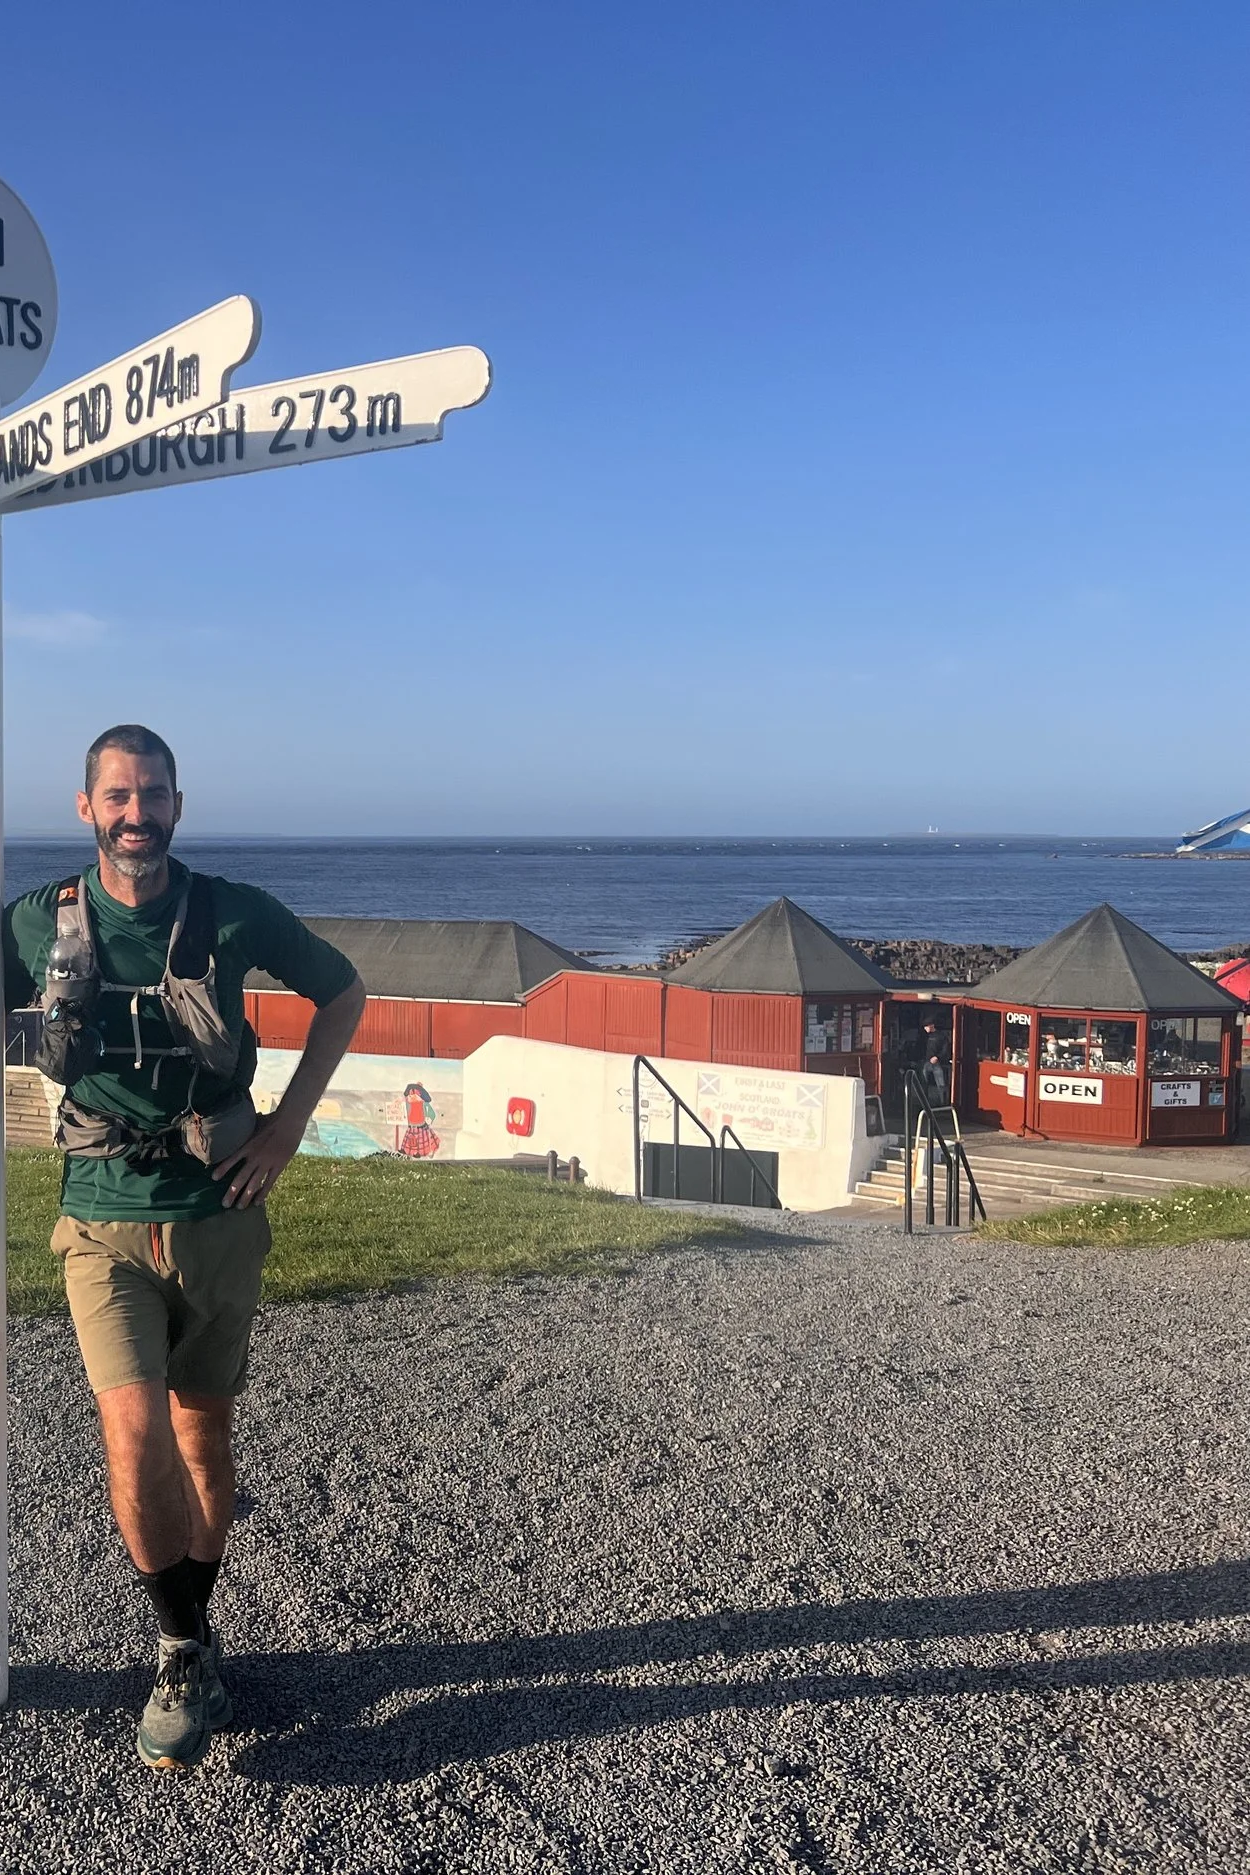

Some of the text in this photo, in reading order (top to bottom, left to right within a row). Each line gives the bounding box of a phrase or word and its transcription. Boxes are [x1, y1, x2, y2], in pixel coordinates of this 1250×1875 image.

[64, 382, 112, 456] END
[125, 345, 200, 425] 874m
[18, 403, 245, 497] NBURGH
[1006, 1012, 1031, 1026] OPEN
[1044, 1083, 1097, 1097] OPEN
[1160, 1083, 1191, 1091] CRAFTS
